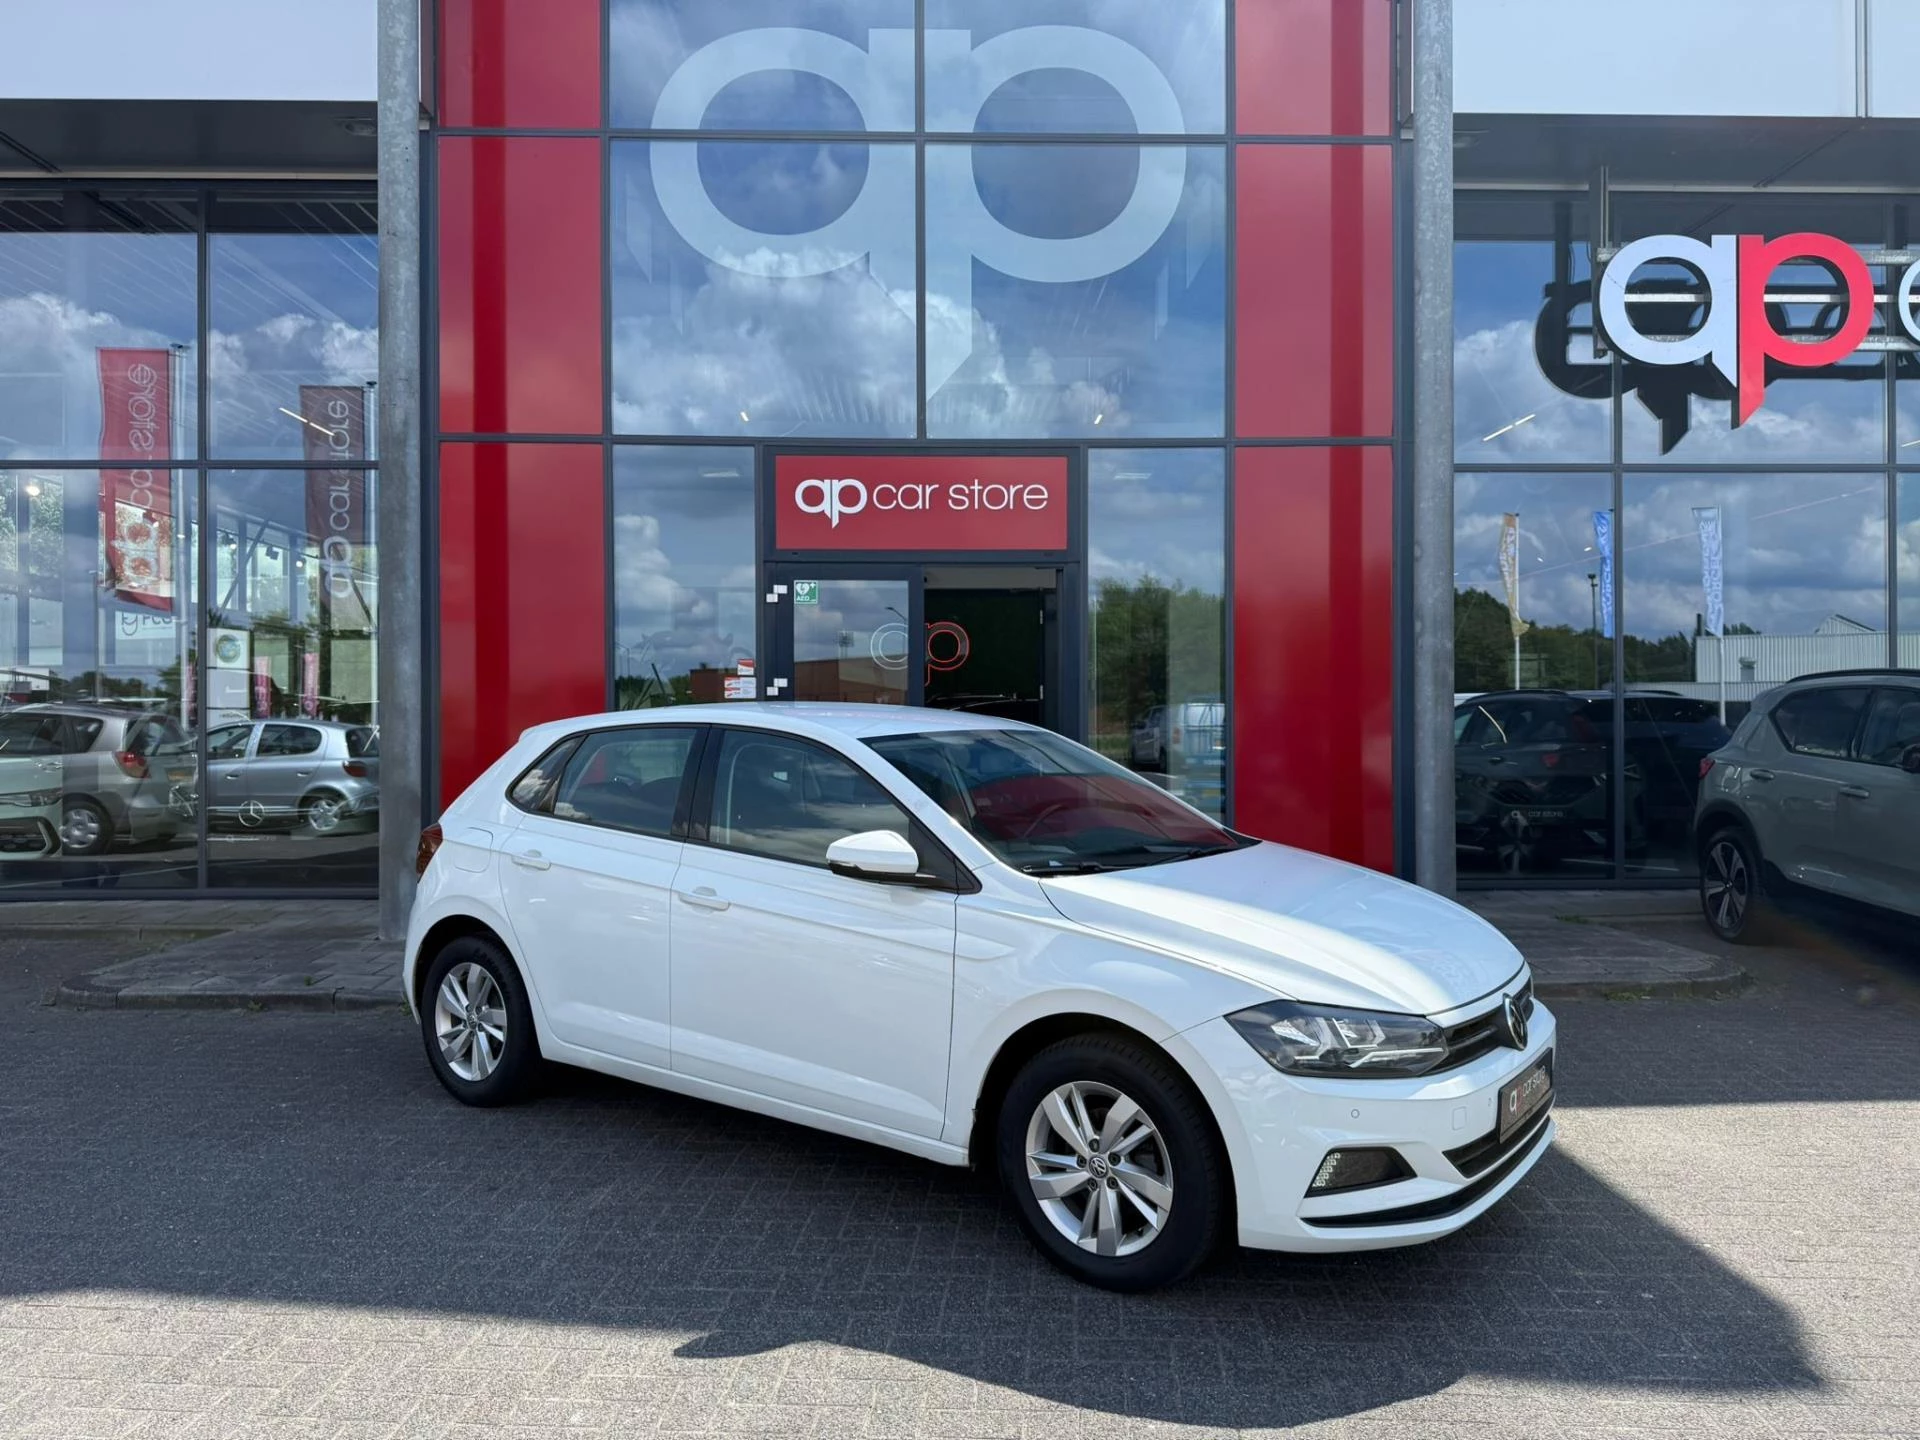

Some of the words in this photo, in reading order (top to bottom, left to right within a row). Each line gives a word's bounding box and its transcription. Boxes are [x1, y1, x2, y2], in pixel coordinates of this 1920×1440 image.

[650, 25, 1187, 403] ap
[1599, 232, 1875, 426] ap
[795, 478, 868, 529] ap
[872, 483, 940, 510] car
[948, 479, 1049, 510] store
